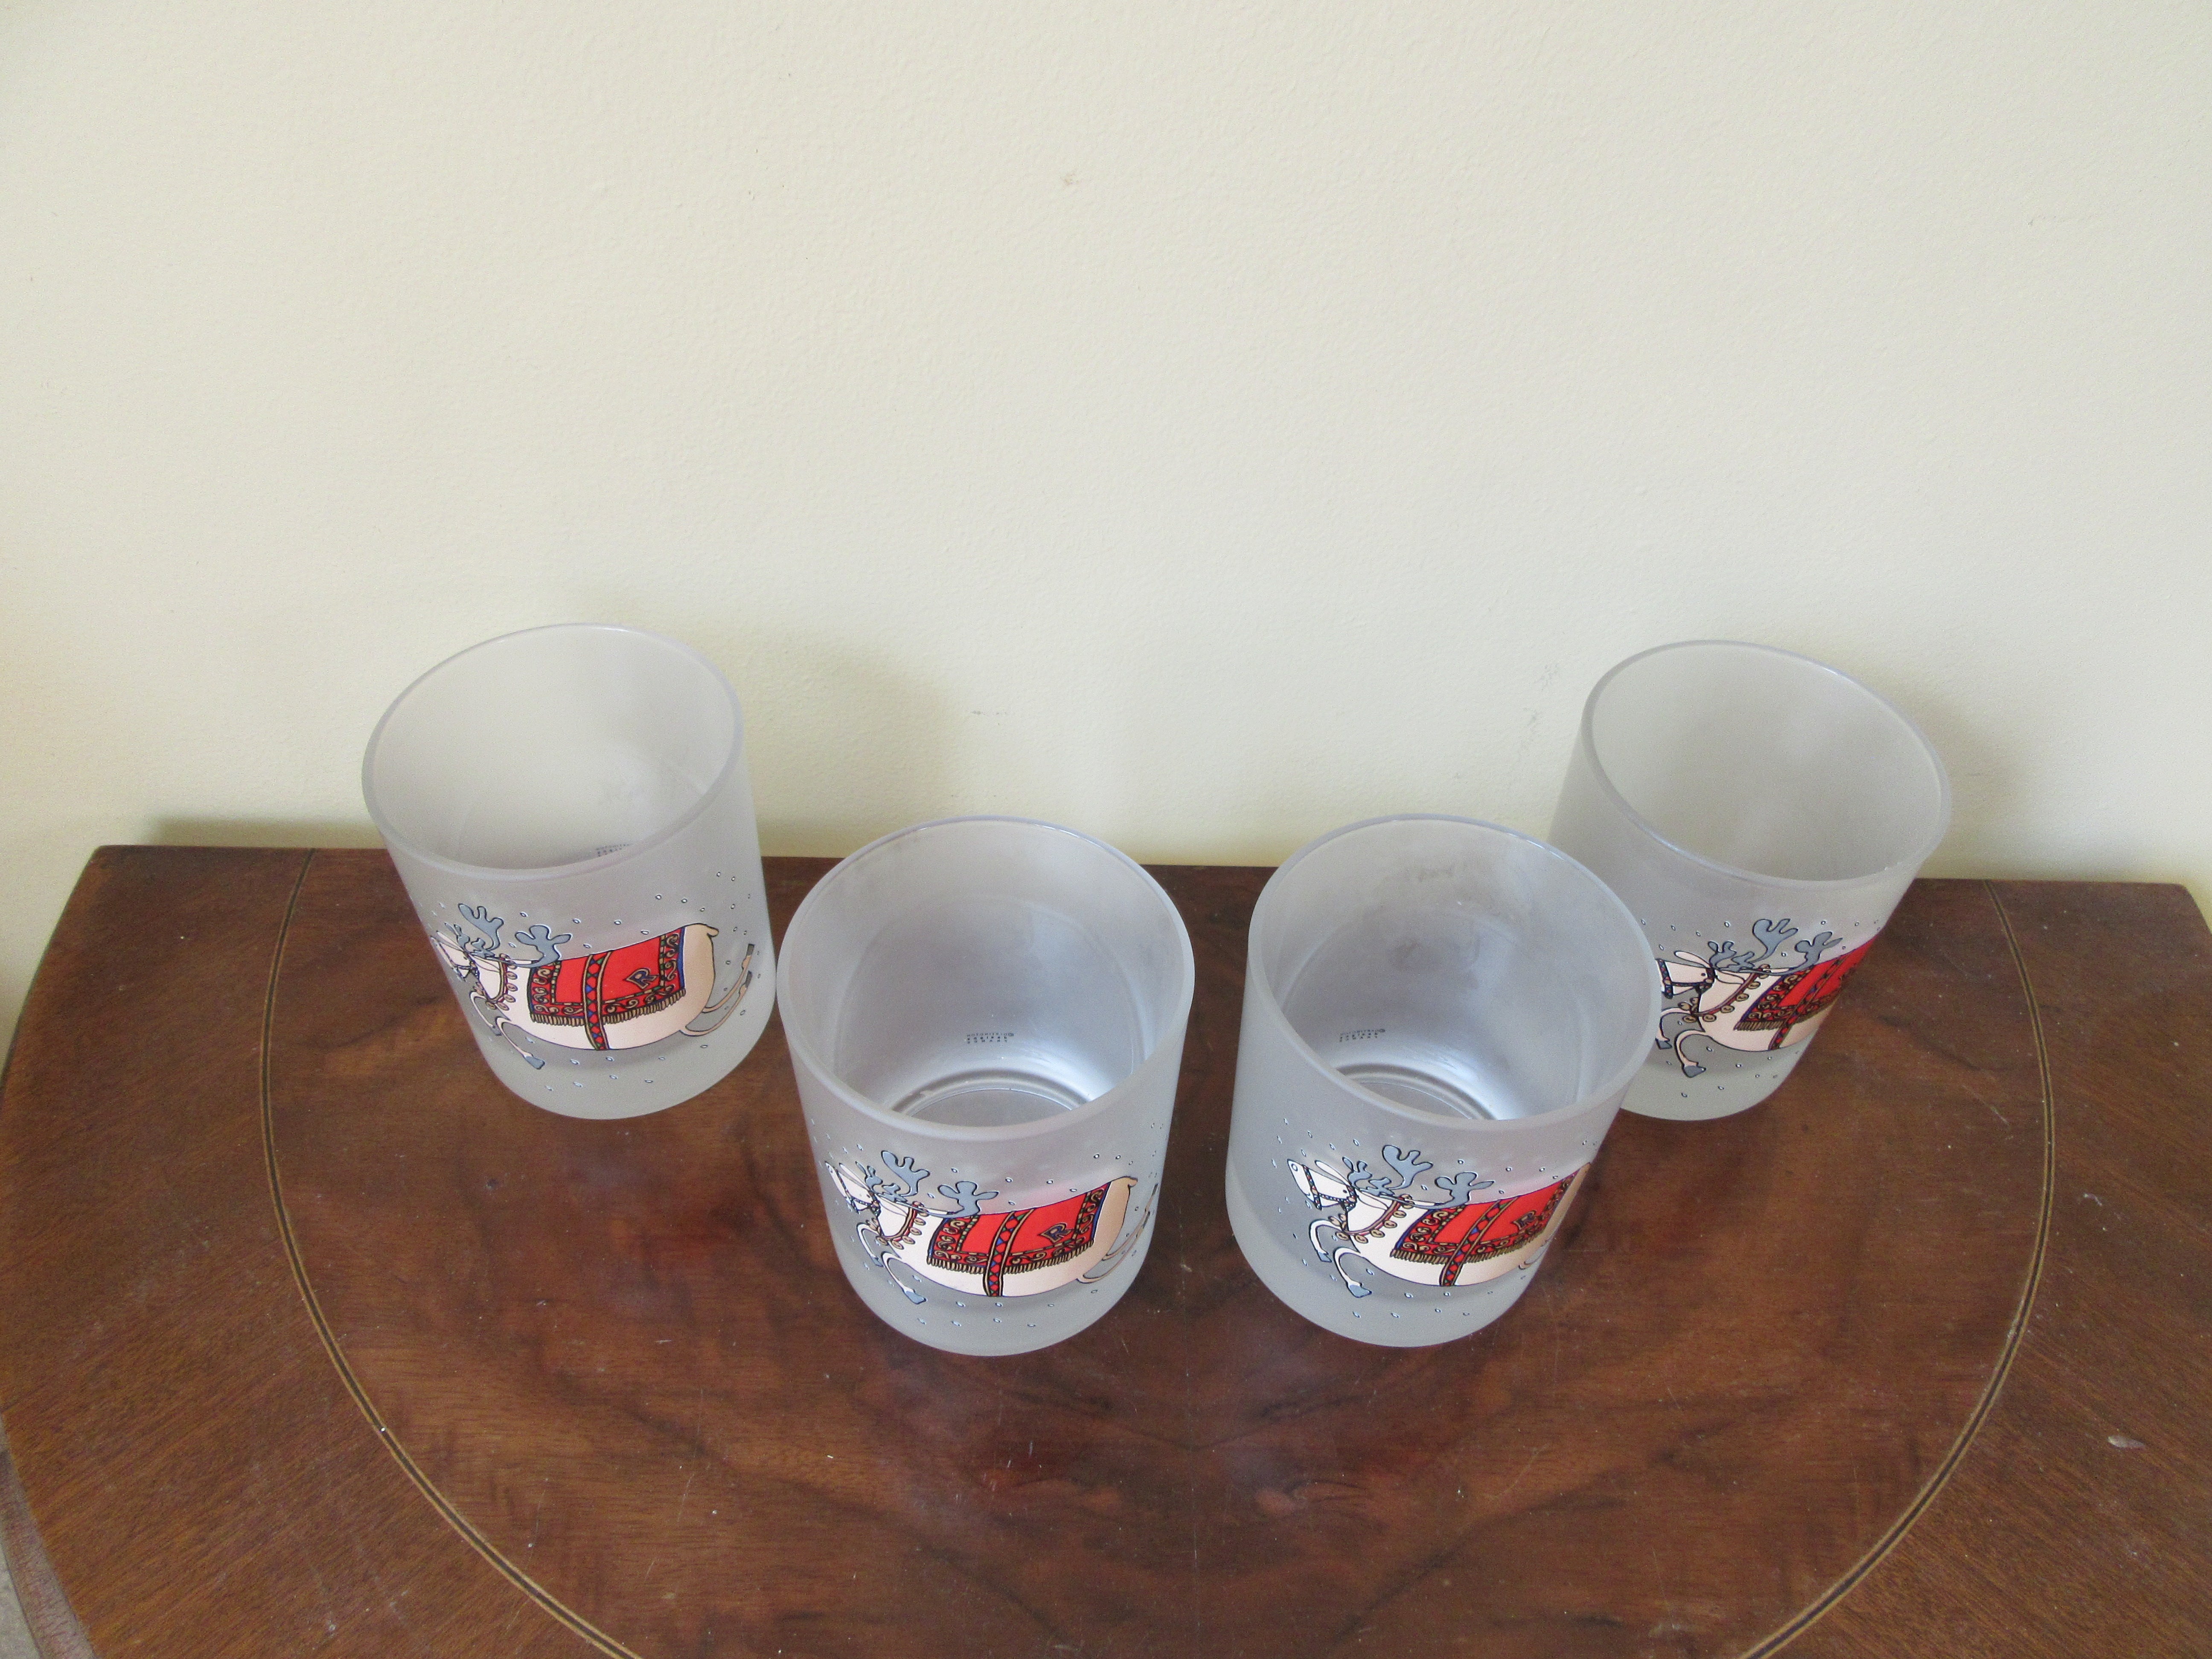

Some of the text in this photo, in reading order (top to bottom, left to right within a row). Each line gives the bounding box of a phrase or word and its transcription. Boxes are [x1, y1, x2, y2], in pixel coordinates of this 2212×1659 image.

[625, 968, 658, 990] R
[1512, 1210, 1537, 1230] R
[1038, 1223, 1071, 1243] R
